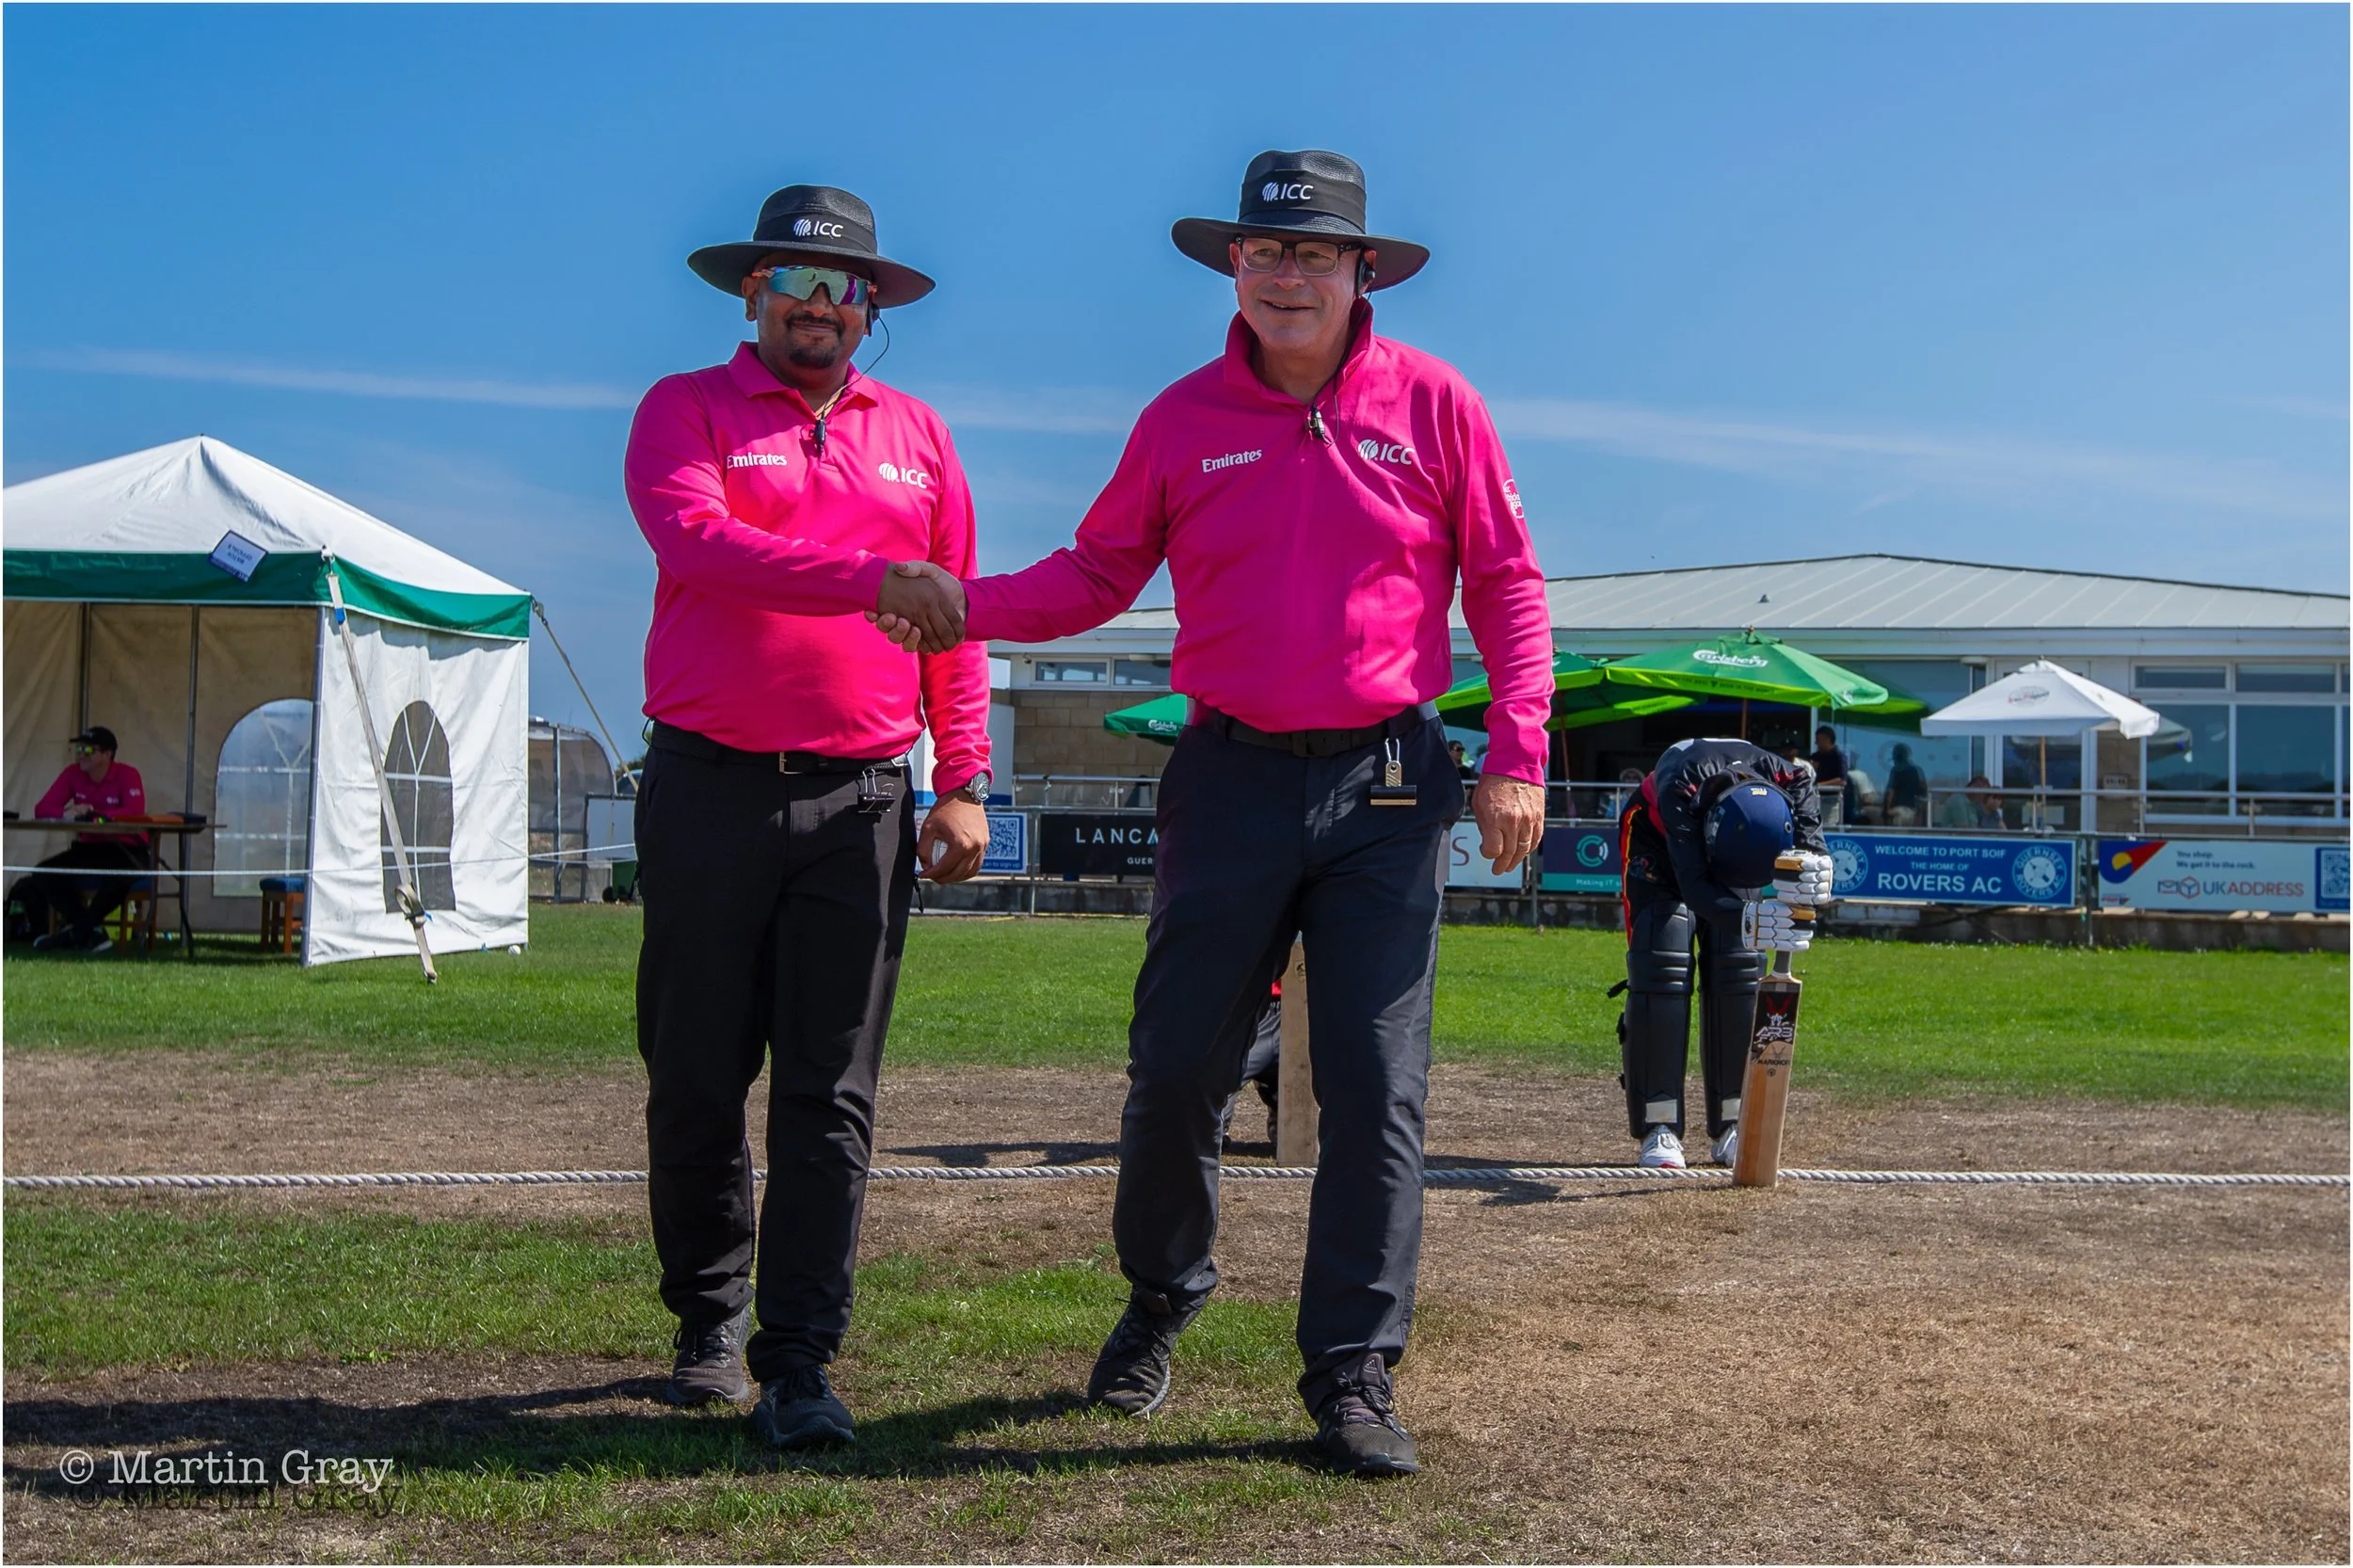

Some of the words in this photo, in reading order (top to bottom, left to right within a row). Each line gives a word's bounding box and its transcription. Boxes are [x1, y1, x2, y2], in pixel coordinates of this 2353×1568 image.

[1280, 183, 1314, 200] ICC
[812, 220, 844, 239] ICC
[727, 452, 788, 470] Emirates
[1201, 449, 1263, 473] Emirates
[1379, 444, 1416, 465] ICC
[901, 468, 928, 489] ICC
[1875, 844, 1929, 856] WELCOME
[1932, 846, 1947, 857] TO
[1949, 847, 1978, 858] PORT
[1910, 861, 1928, 870] THE
[1929, 862, 1957, 871] HOME
[1958, 863, 1970, 872] OF
[1877, 872, 1965, 893] ROVERS
[1971, 876, 2002, 894] AC
